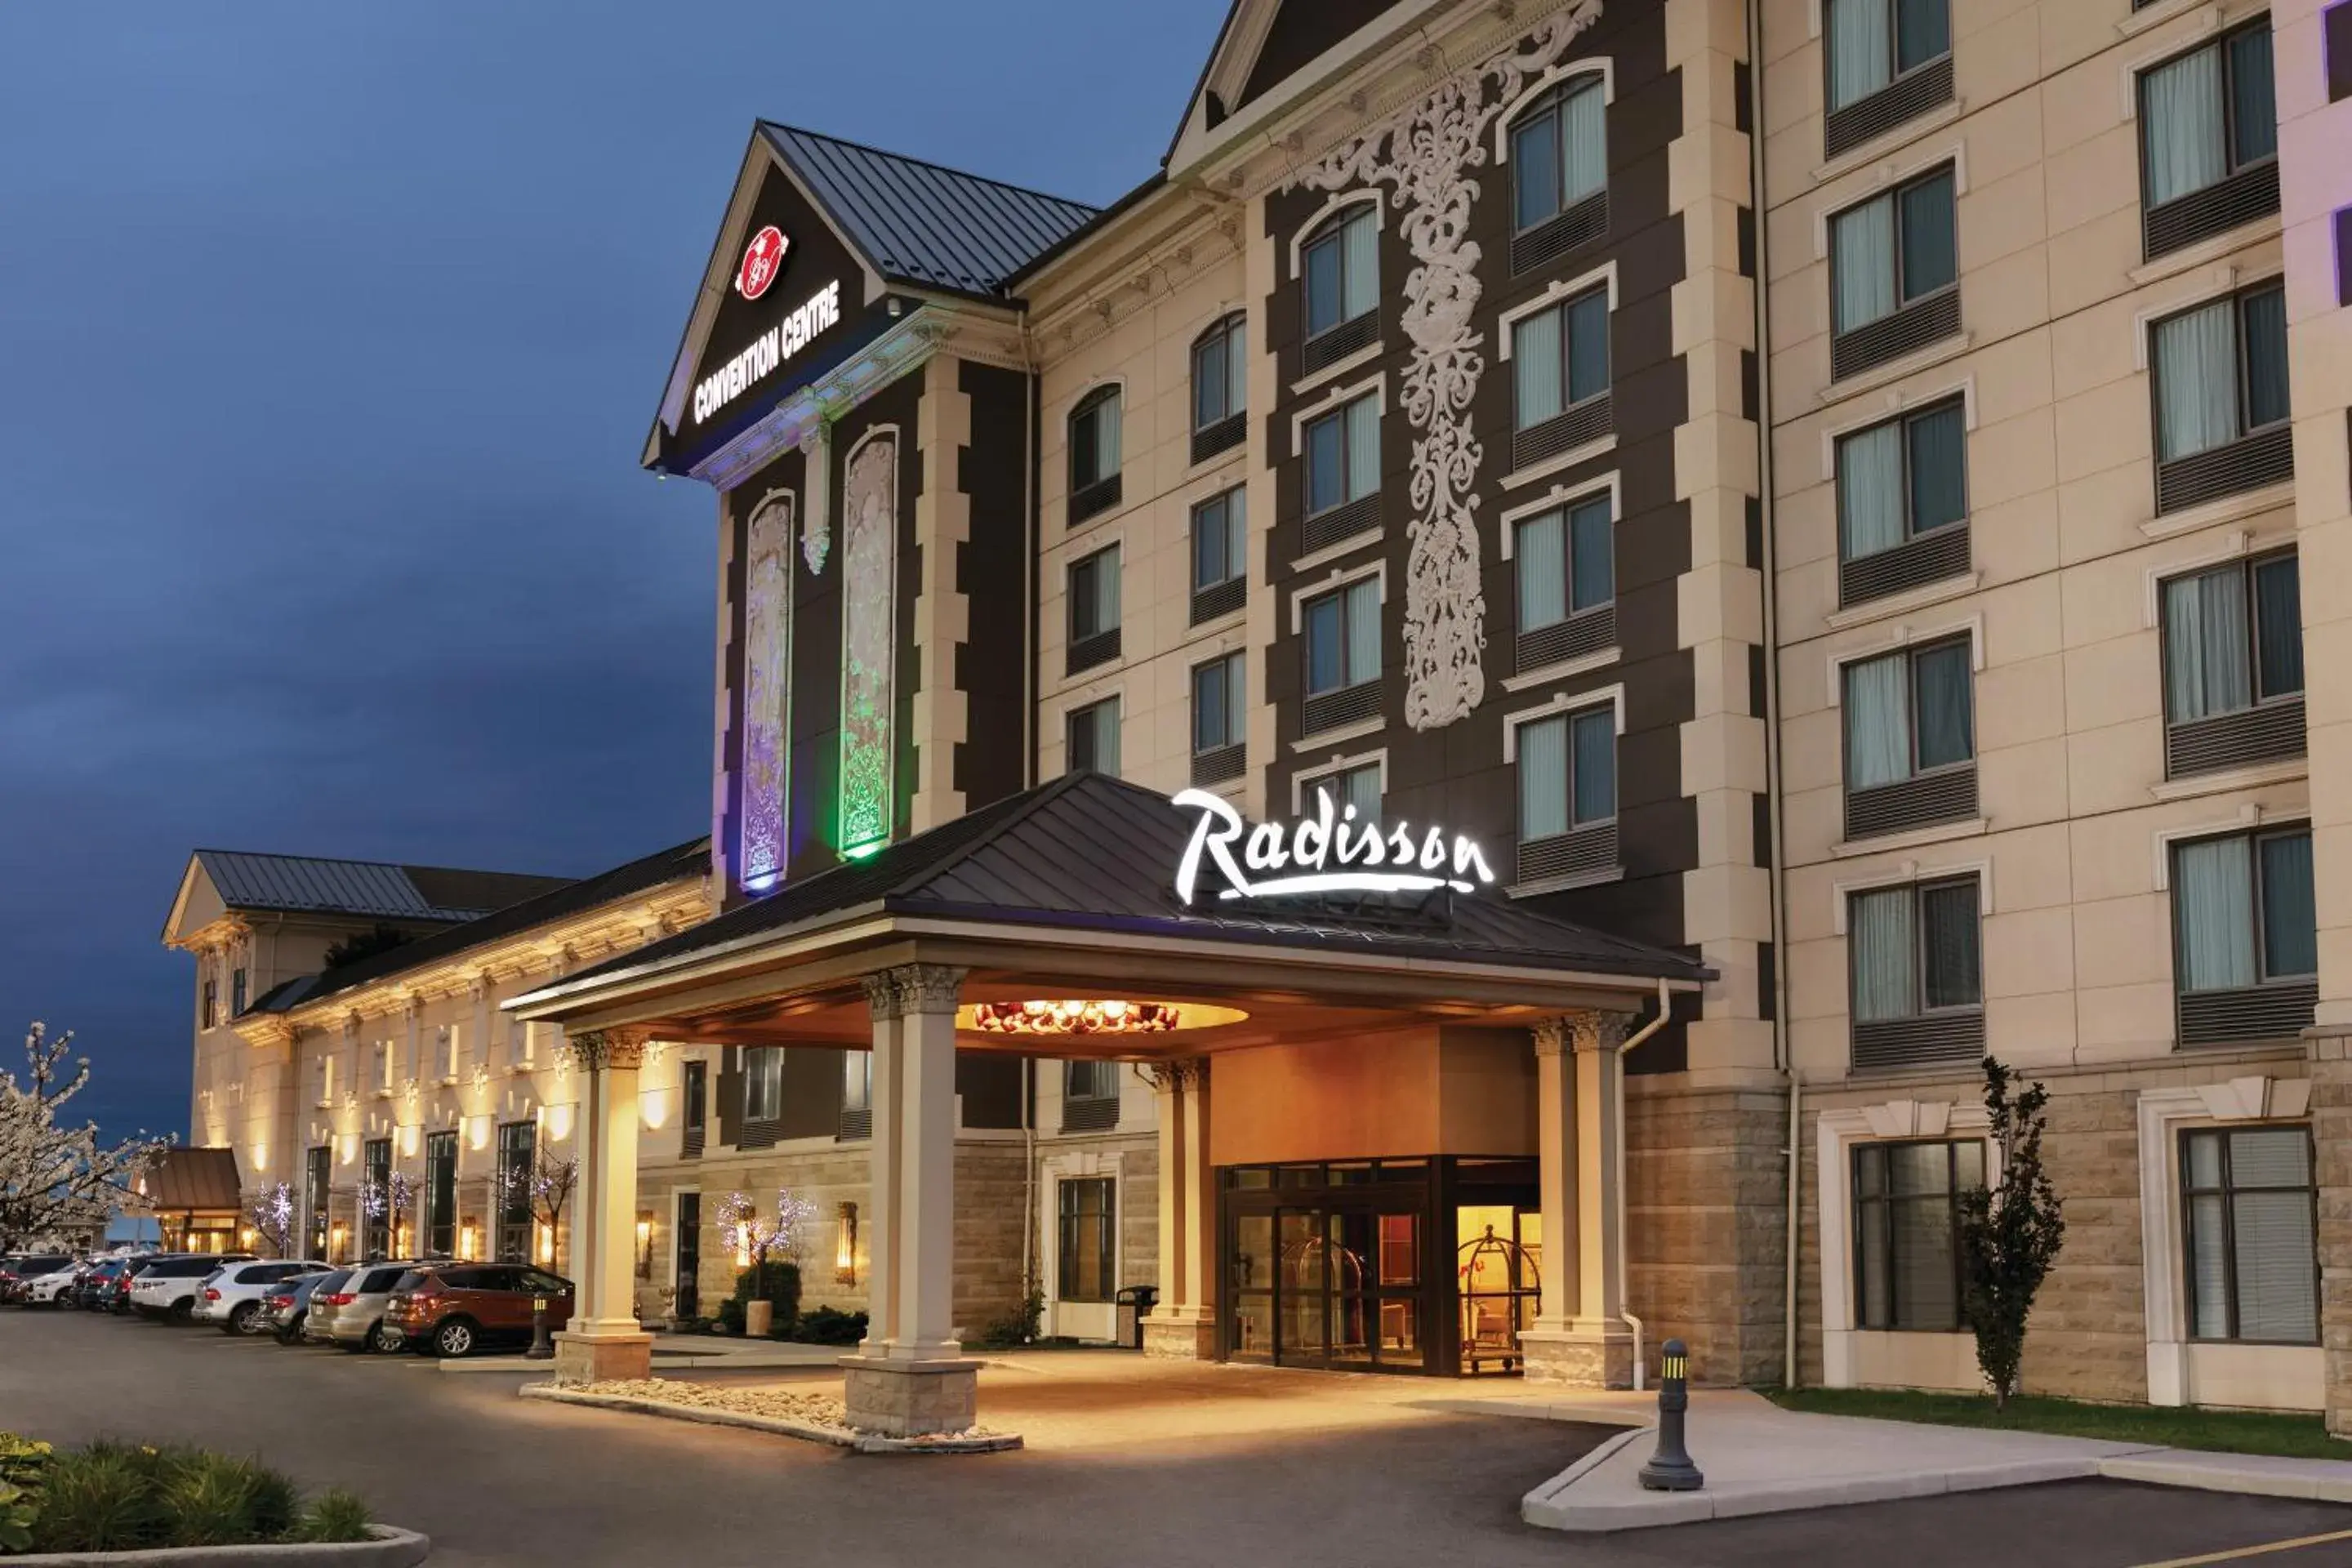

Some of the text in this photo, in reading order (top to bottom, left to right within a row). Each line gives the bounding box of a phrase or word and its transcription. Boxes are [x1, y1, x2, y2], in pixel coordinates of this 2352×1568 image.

[694, 279, 840, 425] CONVENTION CENTRE
[1171, 787, 1495, 905] Radisson
